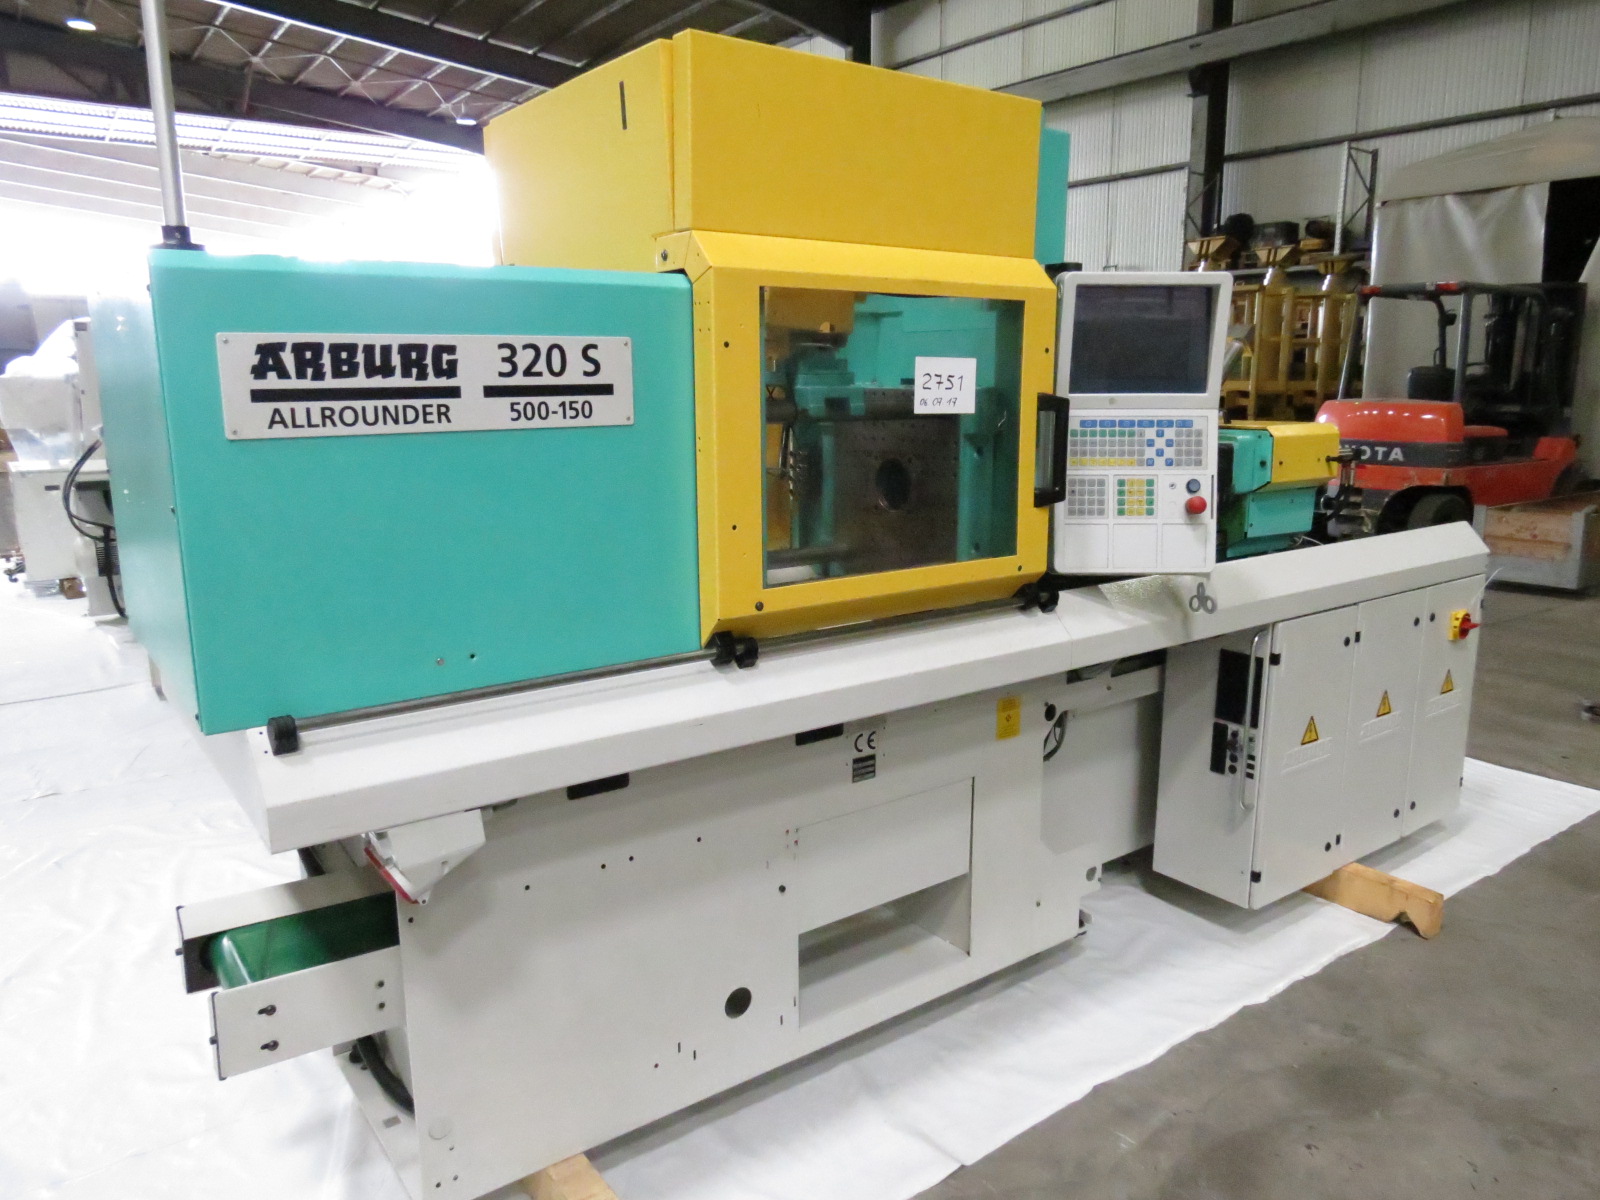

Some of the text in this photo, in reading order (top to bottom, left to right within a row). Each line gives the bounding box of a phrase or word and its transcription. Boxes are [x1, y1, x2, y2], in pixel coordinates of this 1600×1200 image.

[250, 342, 601, 381] ARBURG 320 S
[922, 372, 964, 391] 2751
[267, 400, 593, 430] ALLROUNDER 500-150
[854, 731, 877, 752] CE
